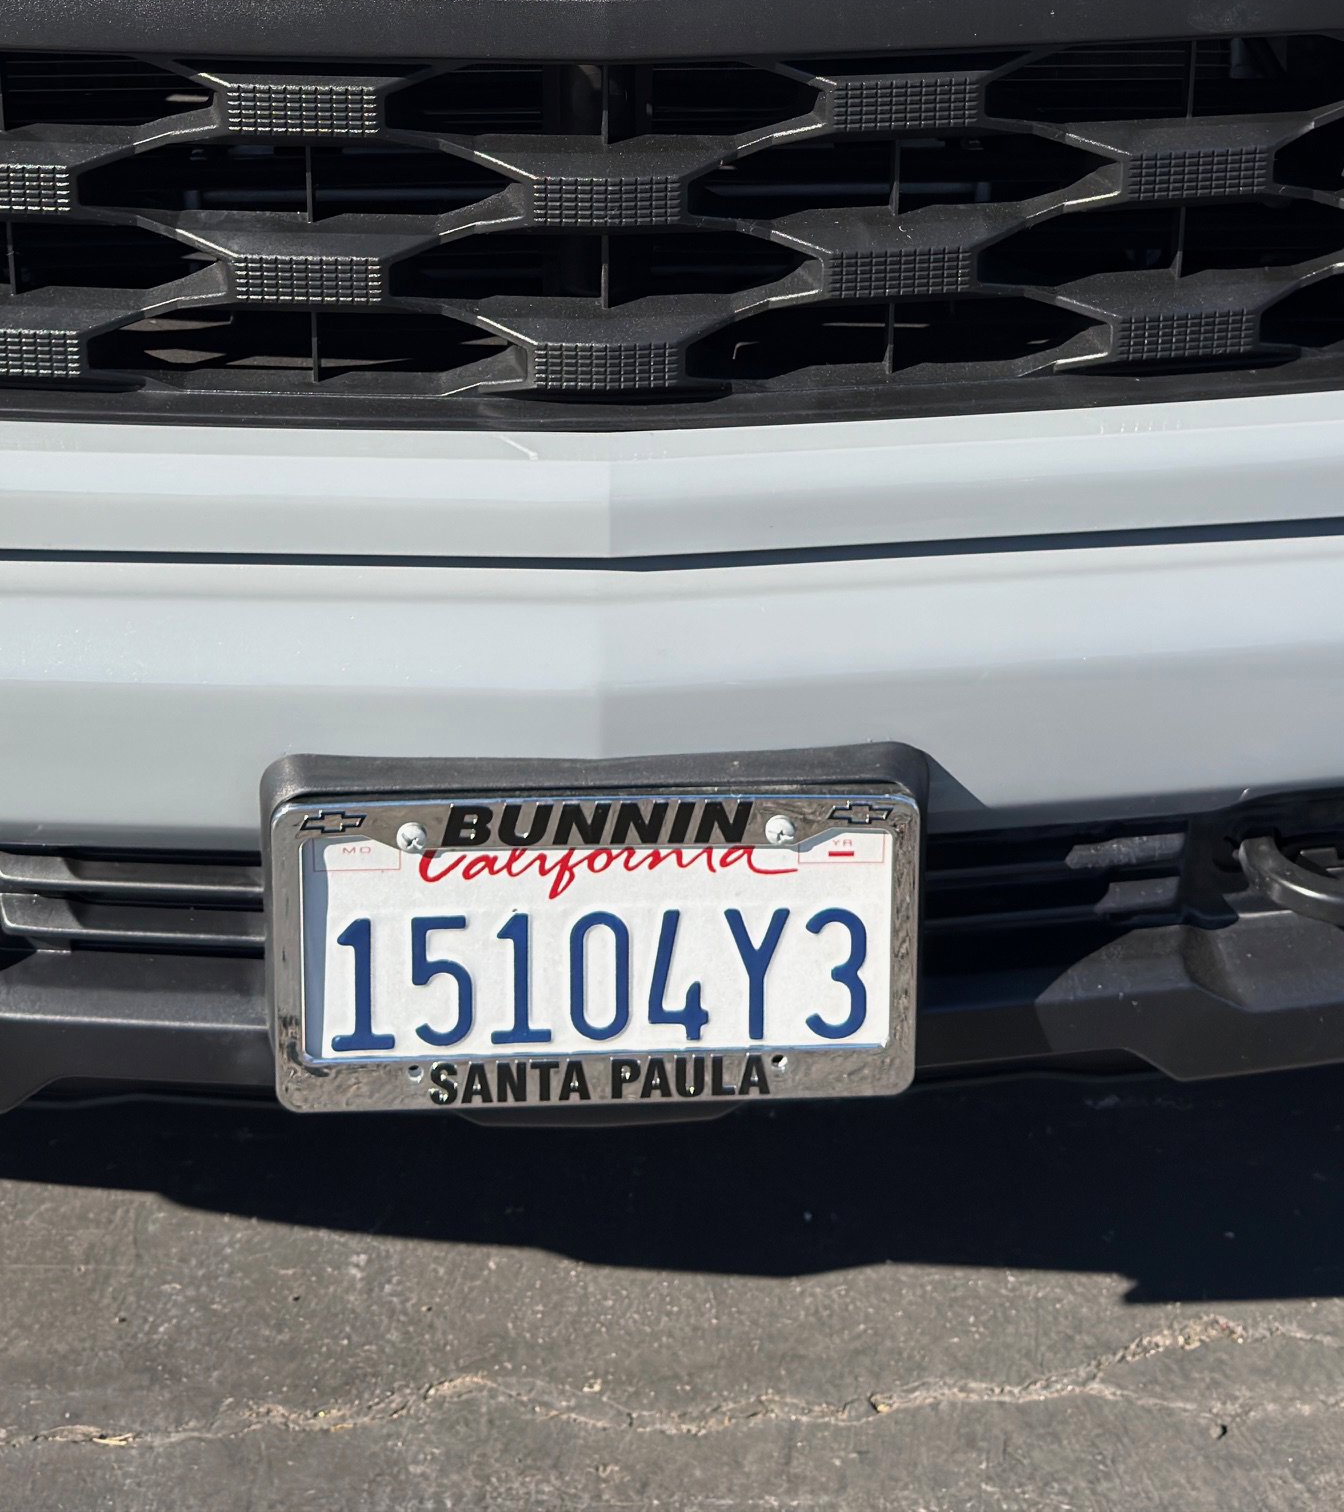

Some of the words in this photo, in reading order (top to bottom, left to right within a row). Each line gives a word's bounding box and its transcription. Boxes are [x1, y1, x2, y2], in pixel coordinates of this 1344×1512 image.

[441, 799, 754, 847] BUNNIN
[342, 846, 372, 855] MO
[418, 845, 798, 900] California
[331, 907, 868, 1052] 15104Y3
[429, 1060, 593, 1106] SANTA
[611, 1054, 771, 1101] PAULA
